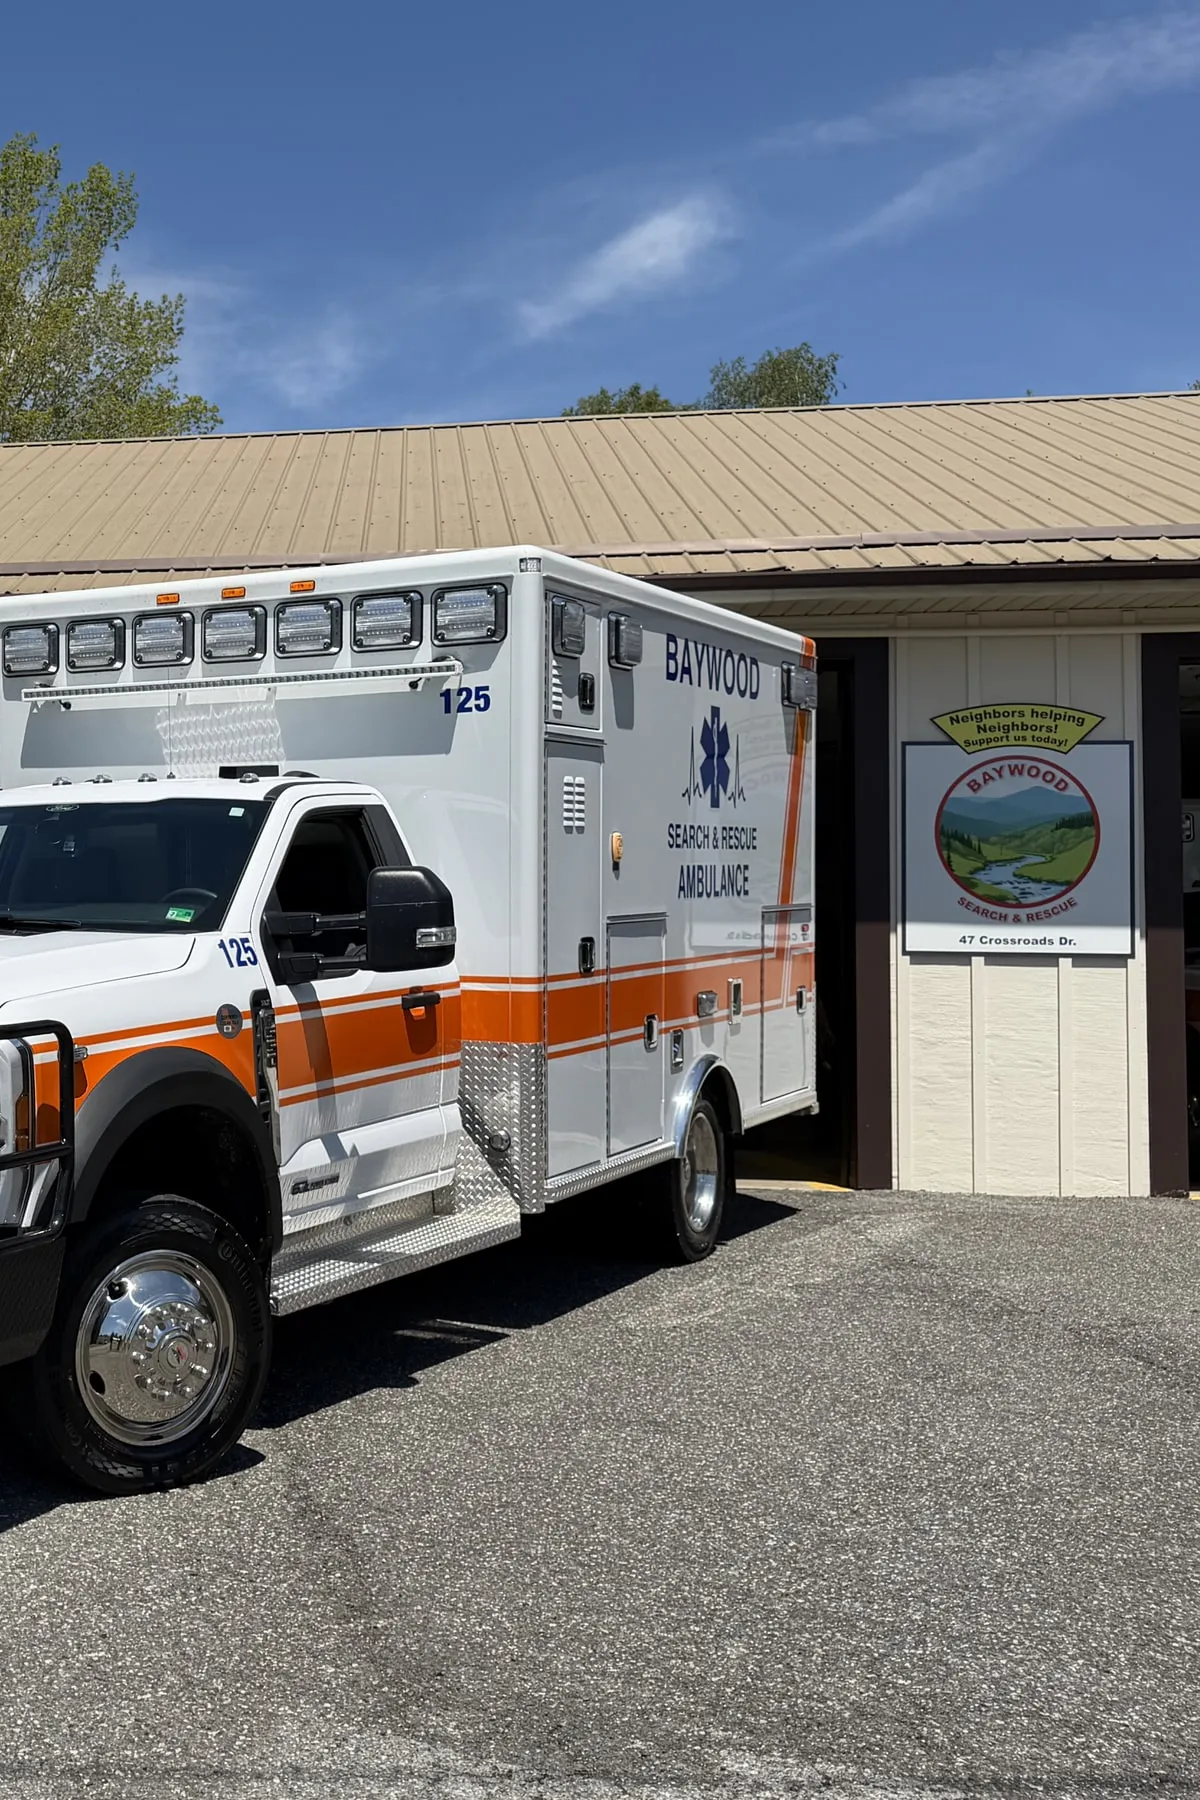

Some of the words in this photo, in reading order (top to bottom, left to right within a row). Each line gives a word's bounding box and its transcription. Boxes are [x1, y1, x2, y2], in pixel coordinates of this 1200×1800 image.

[665, 633, 760, 700] BAYWOOD
[439, 685, 491, 714] 125
[950, 708, 1026, 726] Neighbors
[1030, 708, 1086, 727] helping
[976, 721, 1059, 735] Neighbors!
[963, 734, 1010, 748] Support
[1013, 734, 1027, 742] us
[1031, 734, 1068, 748] today!
[966, 763, 1070, 795] BAYWOOD
[667, 823, 710, 850] SEARCH
[712, 828, 720, 850] &
[721, 826, 757, 851] RESCUE
[678, 863, 749, 899] AMBULANCE
[957, 896, 1008, 923] SEARCH
[1012, 913, 1022, 924] &
[1026, 896, 1078, 923] RESCUE
[217, 937, 258, 968] 125
[959, 935, 975, 945] 47
[979, 935, 1055, 946] Crossroads
[1059, 936, 1077, 946] Dr.
